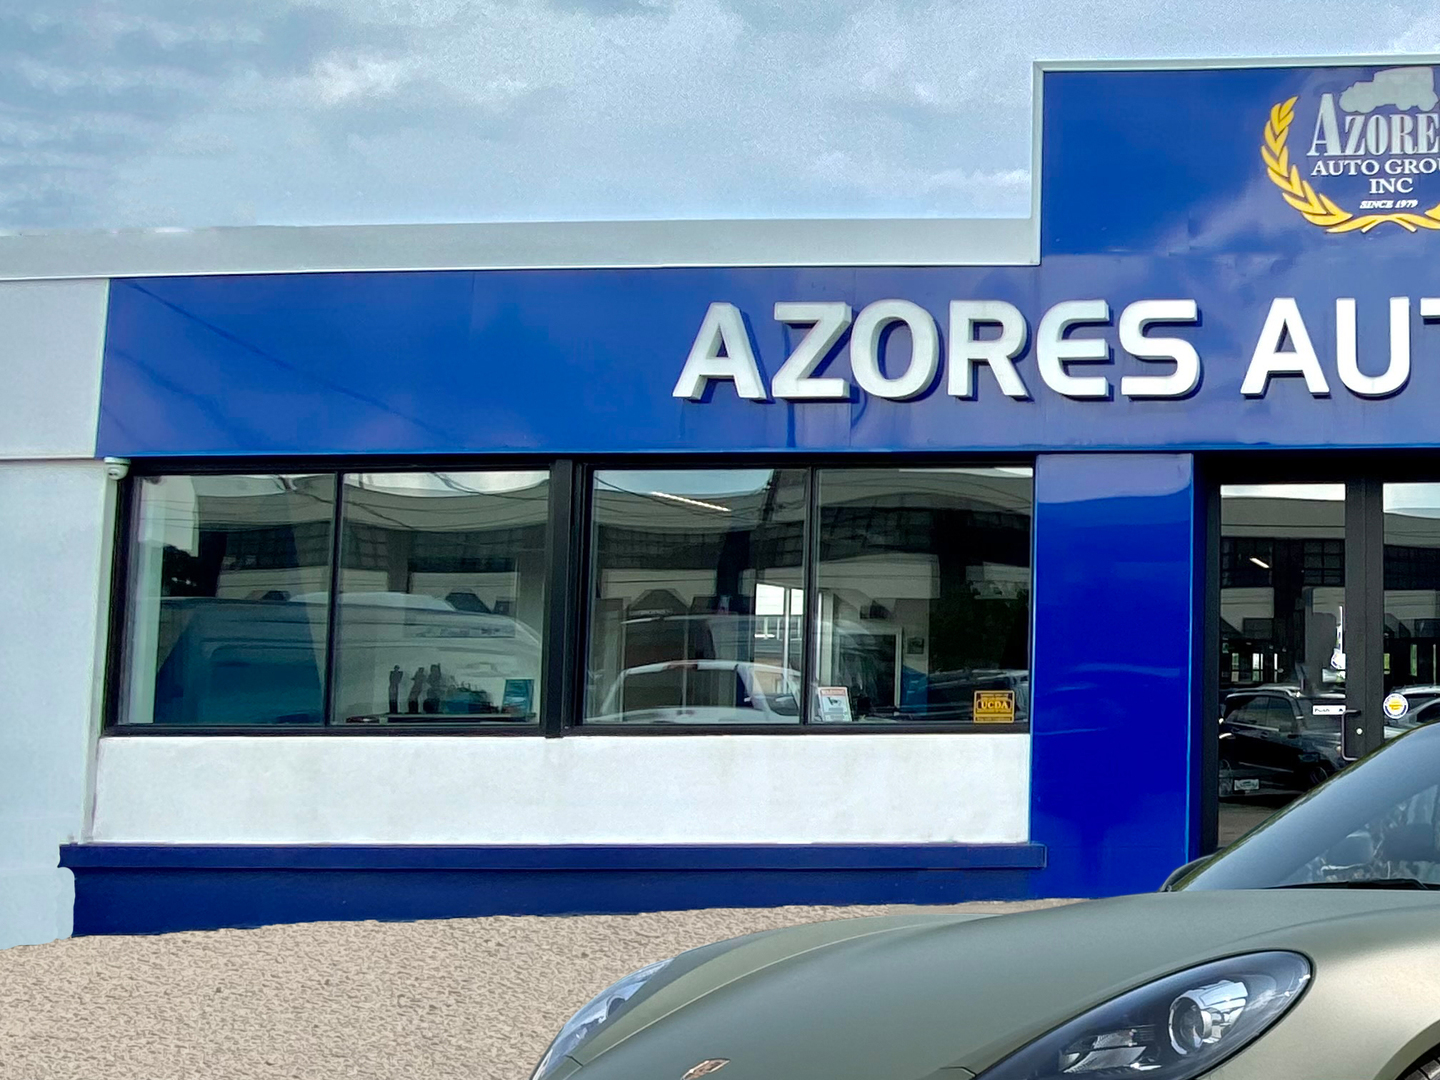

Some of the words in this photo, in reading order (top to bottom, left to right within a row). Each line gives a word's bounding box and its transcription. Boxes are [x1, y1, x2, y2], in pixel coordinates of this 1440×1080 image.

[1311, 159, 1380, 176] AUTO
[1369, 178, 1413, 194] INC
[1360, 200, 1393, 209] SINCE
[1395, 199, 1418, 208] 1979
[672, 299, 1201, 401] AZORES
[981, 700, 1009, 709] UCDA
